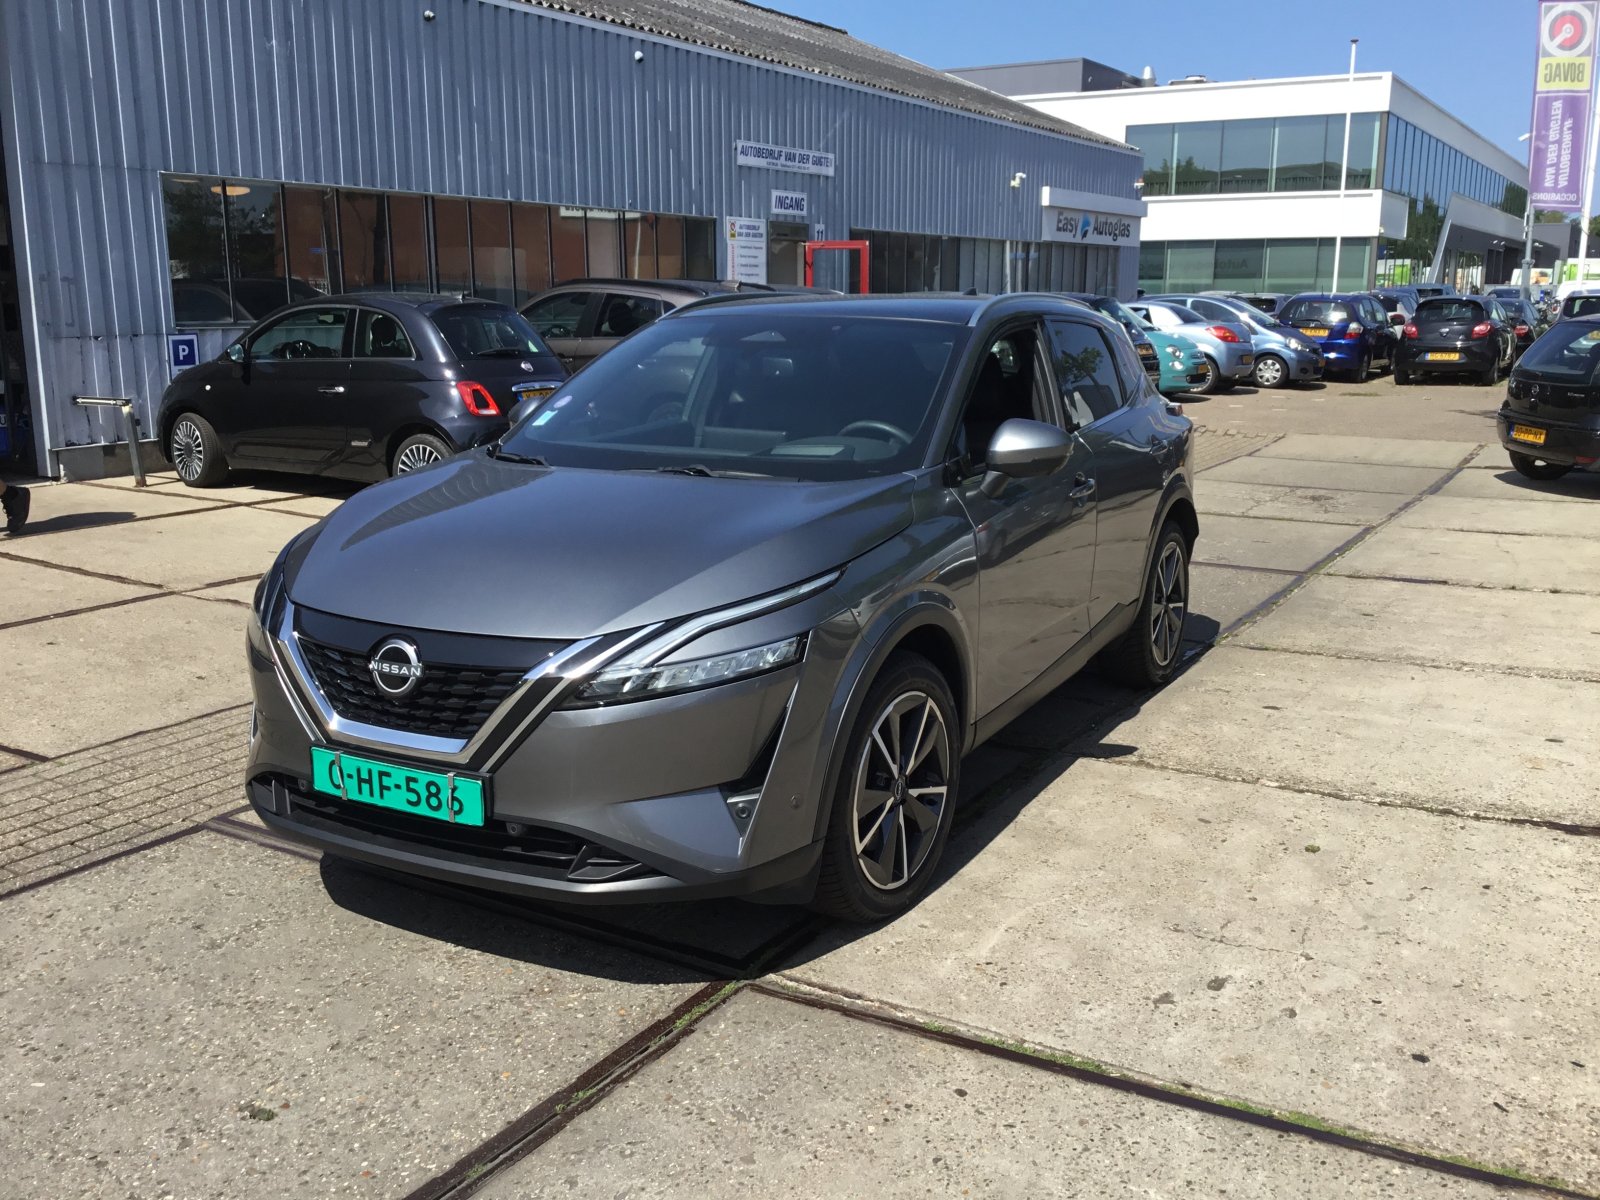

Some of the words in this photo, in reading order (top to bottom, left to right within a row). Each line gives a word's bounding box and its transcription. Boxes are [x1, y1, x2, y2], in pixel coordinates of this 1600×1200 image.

[740, 144, 783, 161] AUTOBEDRIJF
[784, 150, 797, 163] VAN
[798, 152, 811, 165] DER
[774, 194, 805, 211] INGANG
[1056, 210, 1079, 238] Easy
[1092, 215, 1131, 241] Autoglas
[816, 229, 824, 241] 11
[179, 344, 189, 360] P
[370, 660, 421, 676] NISSAN
